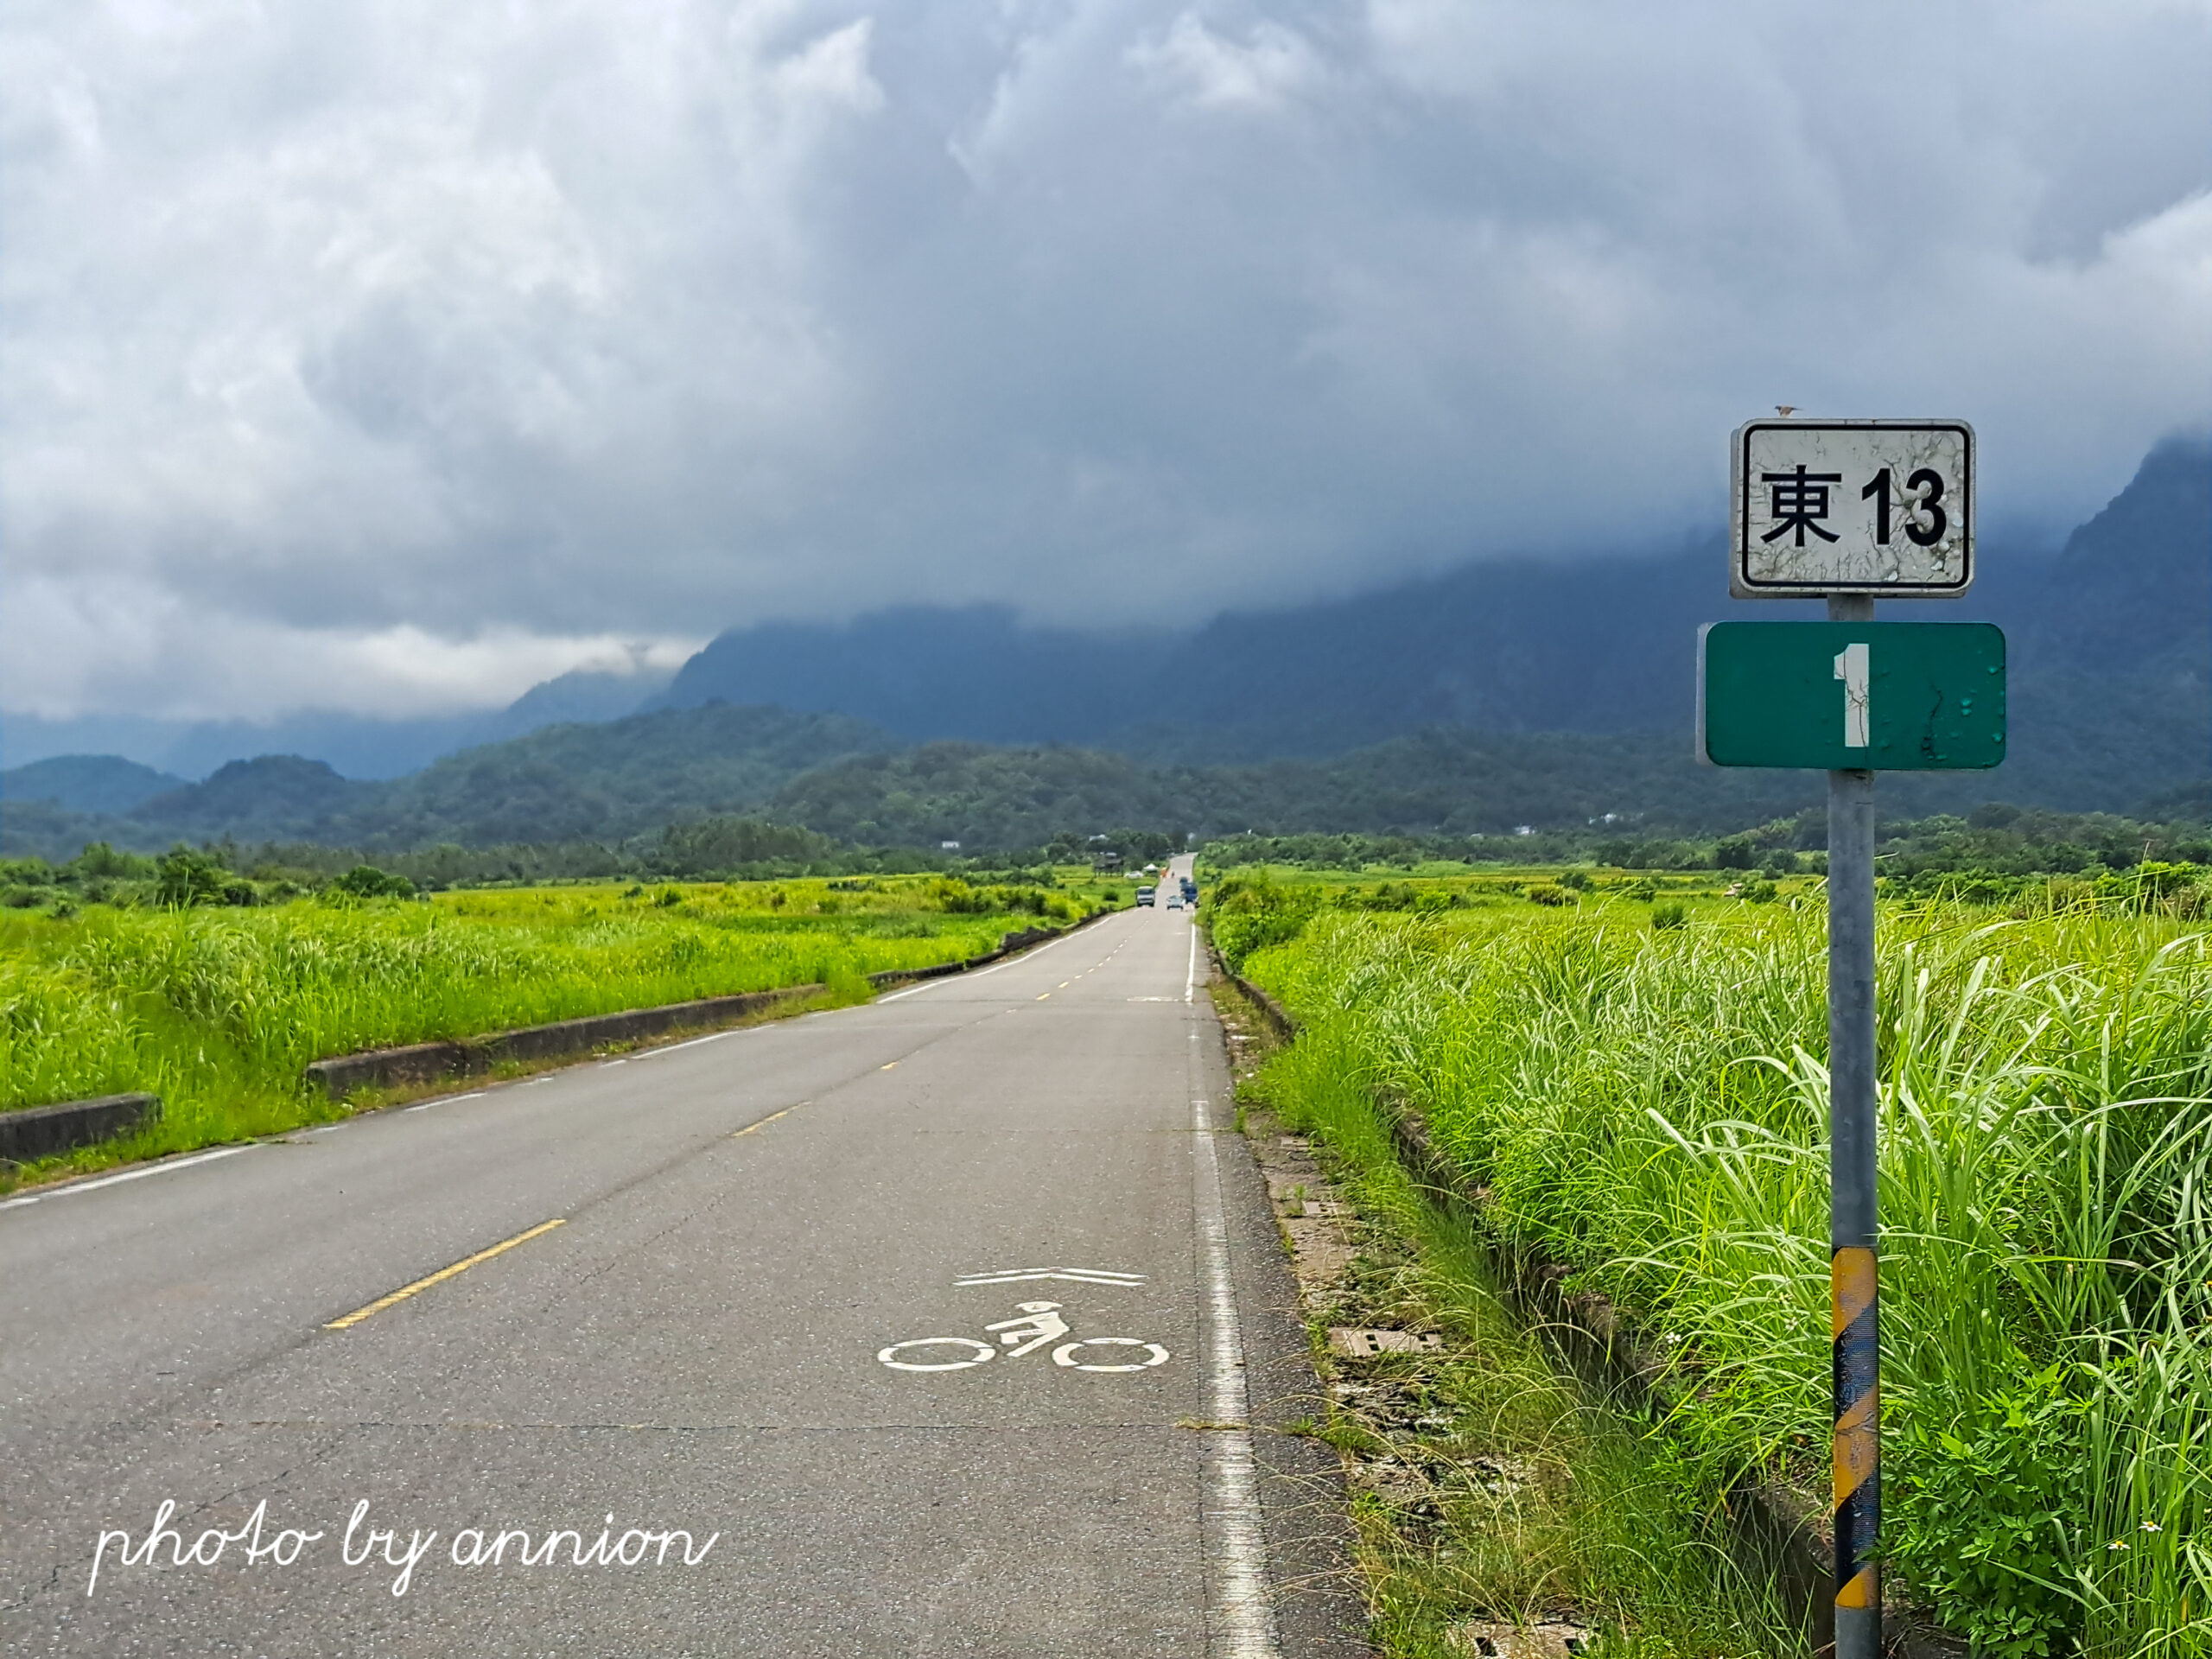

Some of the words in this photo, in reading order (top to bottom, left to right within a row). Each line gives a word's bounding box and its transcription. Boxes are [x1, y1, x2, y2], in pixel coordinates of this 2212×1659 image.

[1760, 464, 1842, 547] 東
[1861, 467, 1948, 546] 13
[1834, 643, 1869, 747] 1
